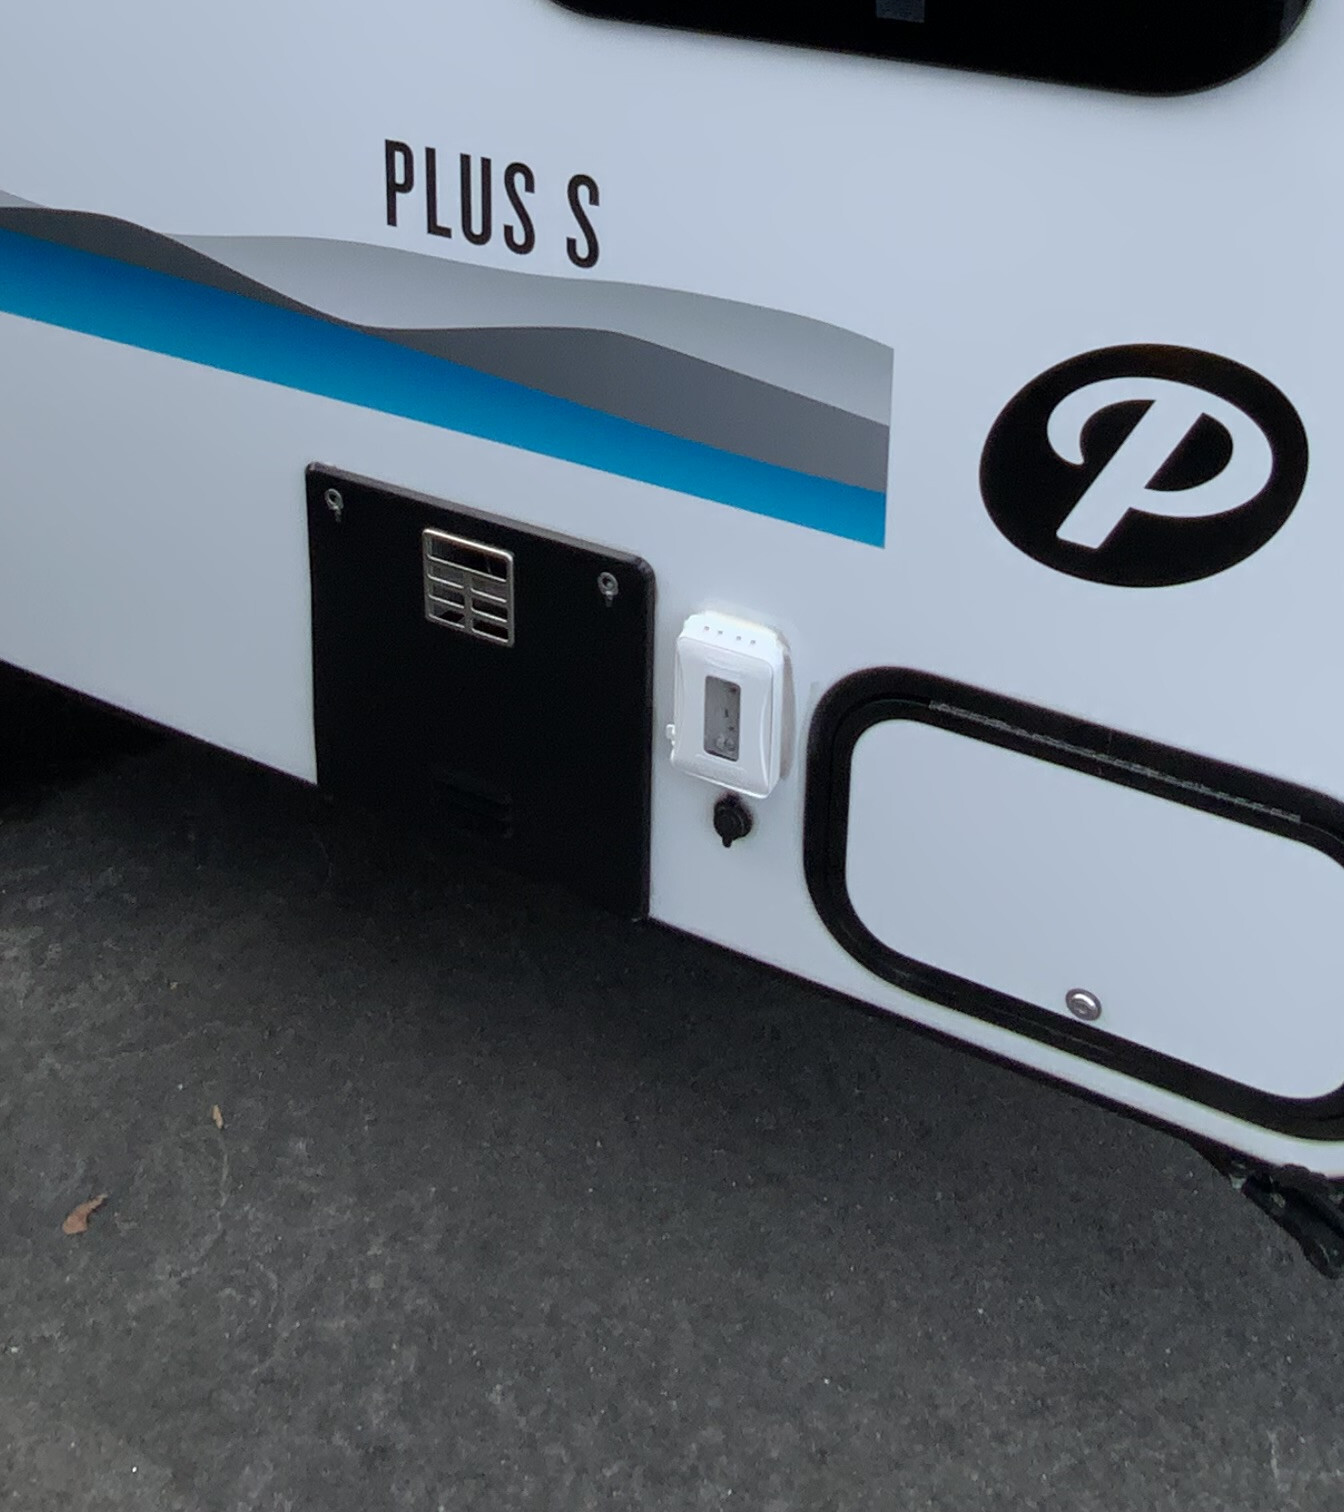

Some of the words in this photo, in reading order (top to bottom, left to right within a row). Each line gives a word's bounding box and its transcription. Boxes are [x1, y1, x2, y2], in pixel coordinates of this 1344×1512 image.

[384, 138, 536, 256] PLUS
[565, 173, 600, 269] S
[1046, 375, 1274, 550] P
